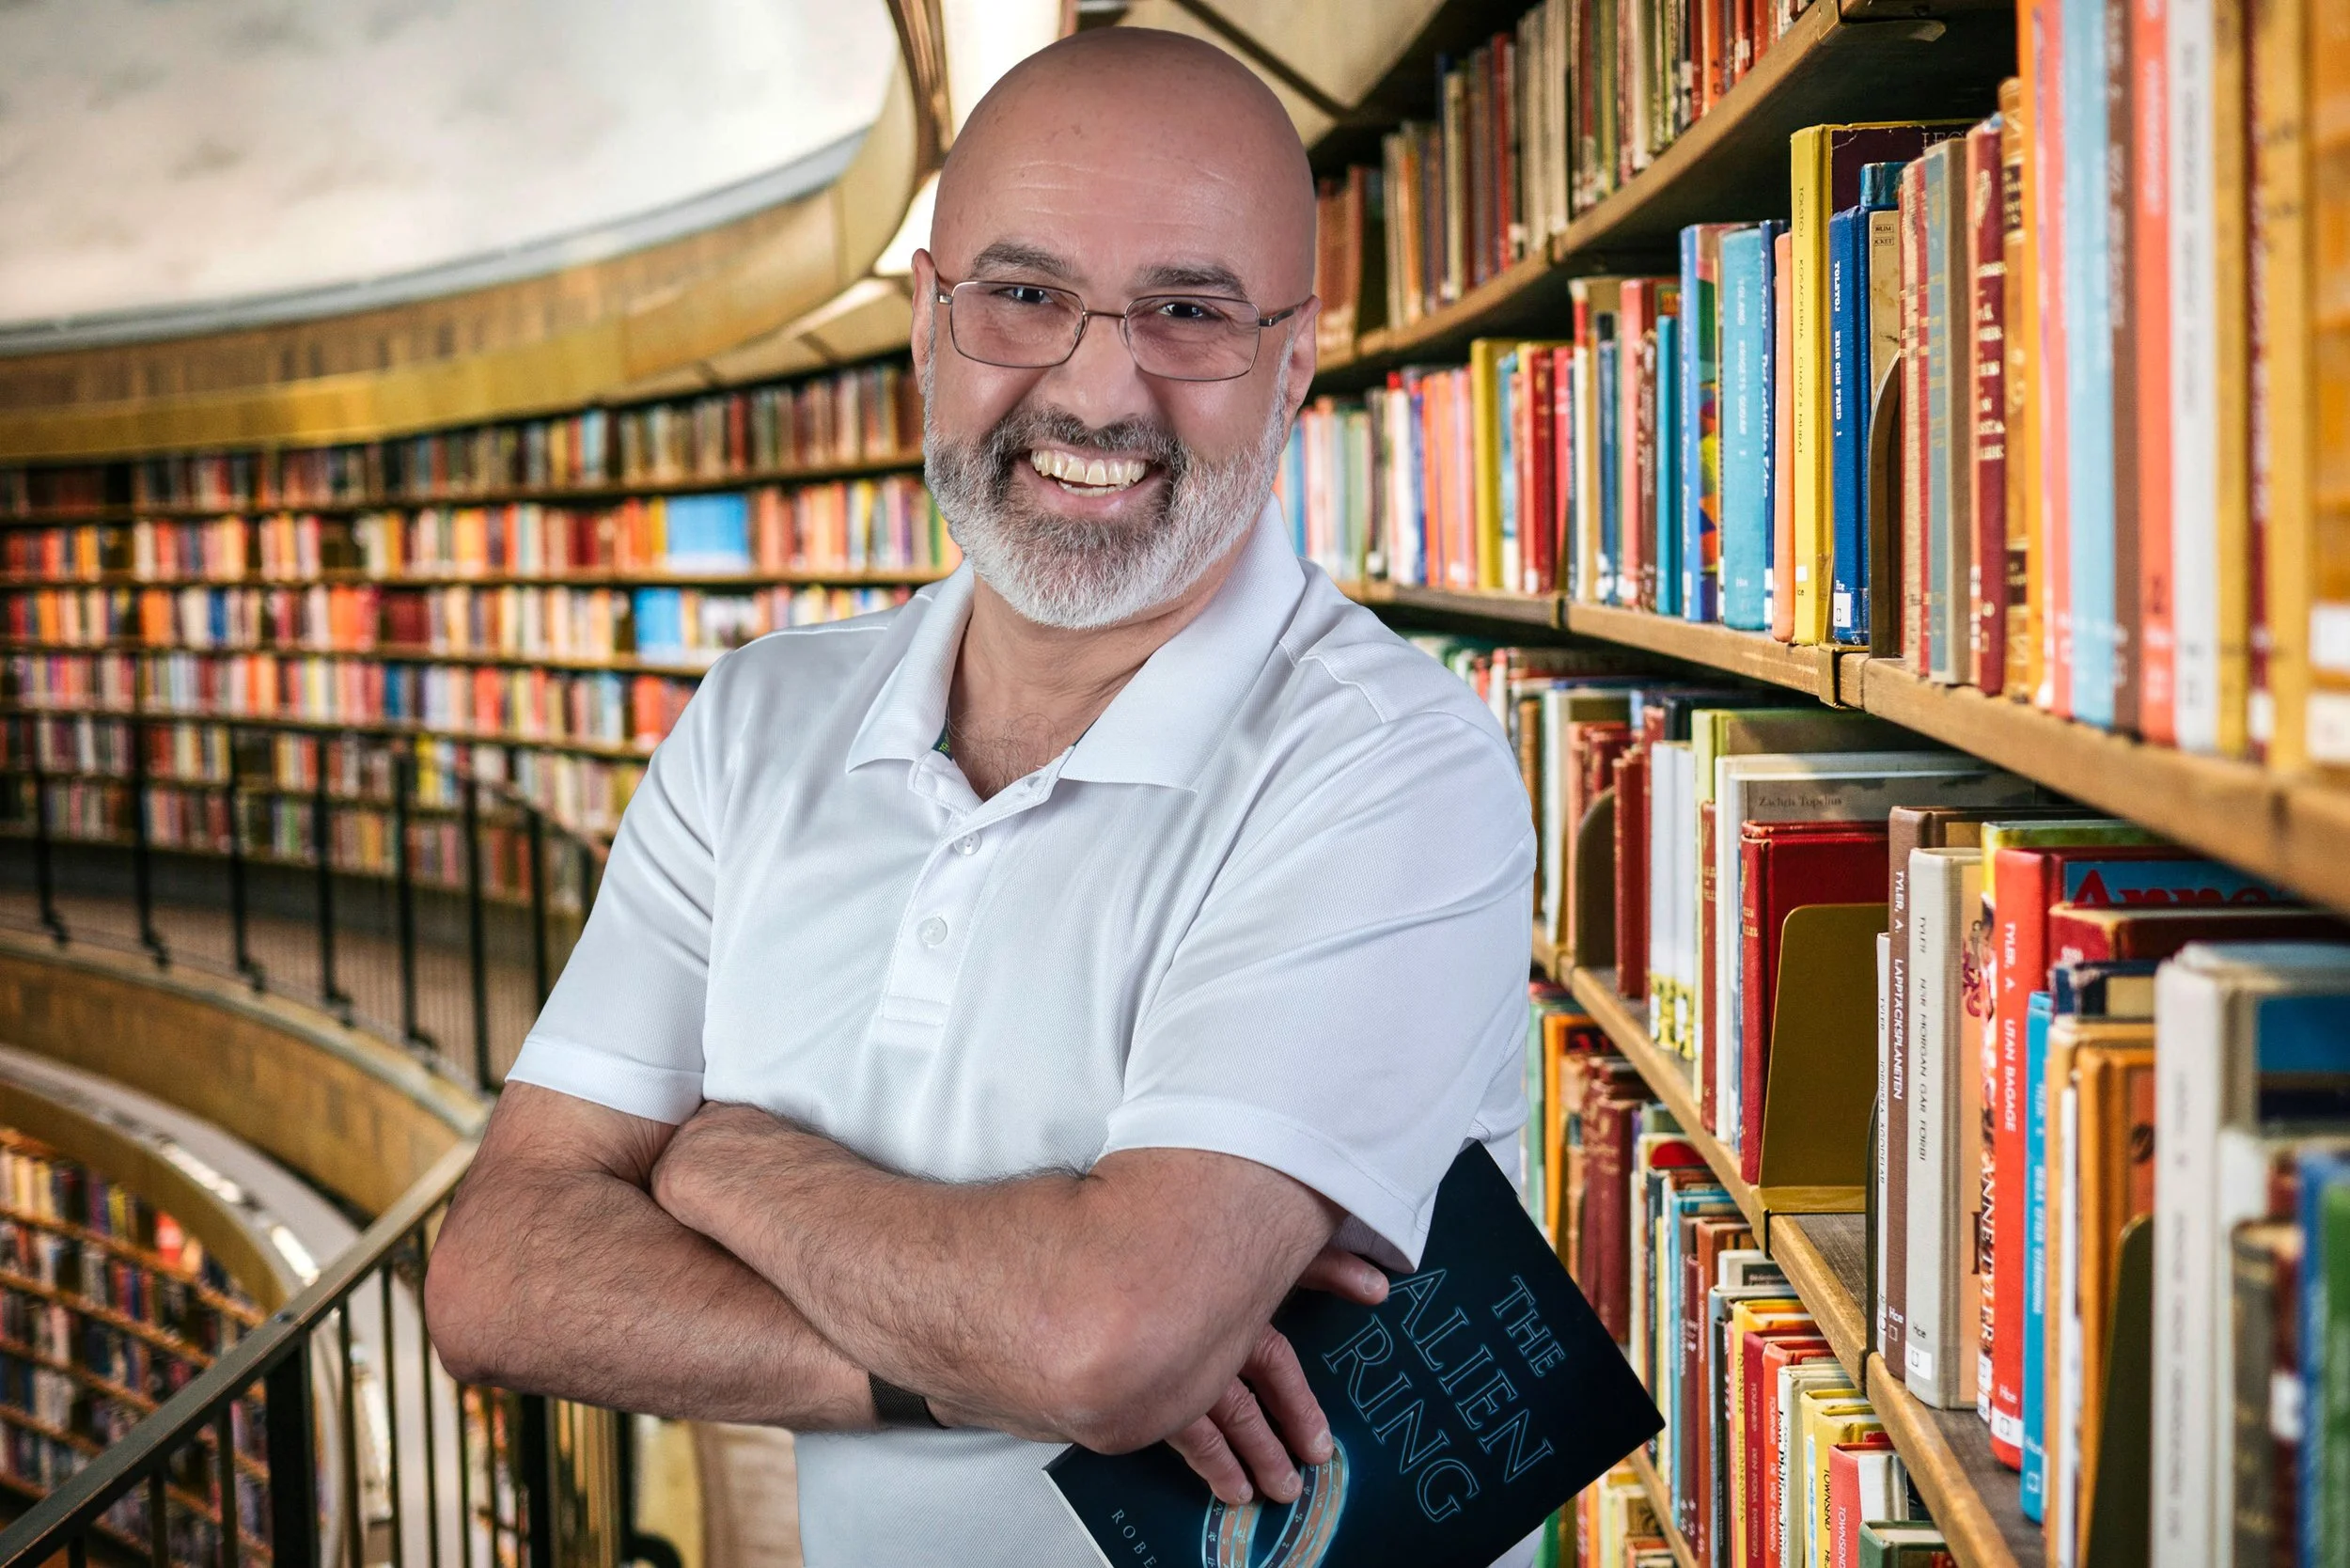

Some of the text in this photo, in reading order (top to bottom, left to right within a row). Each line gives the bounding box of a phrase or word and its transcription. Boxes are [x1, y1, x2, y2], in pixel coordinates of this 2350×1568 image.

[1759, 796, 1842, 809] Zachris Topelius
[1894, 870, 1904, 912] TYLER,
[1894, 918, 1904, 933] A.
[2004, 922, 2016, 969] TYLER,
[2004, 1019, 2016, 1061] UTAN
[2004, 1066, 2017, 1133] BAGAGE
[1979, 1154, 1996, 1342] ANNE TYLER
[1492, 1275, 1564, 1377] THE
[1888, 1305, 1904, 1325] Hce
[1386, 1269, 1554, 1482] ALIEN
[1322, 1313, 1480, 1523] RING
[1823, 1469, 1831, 1531] TOWNSEND
[1111, 1508, 1157, 1568] ROBE
[1838, 1506, 1847, 1568] TOWNSEND
